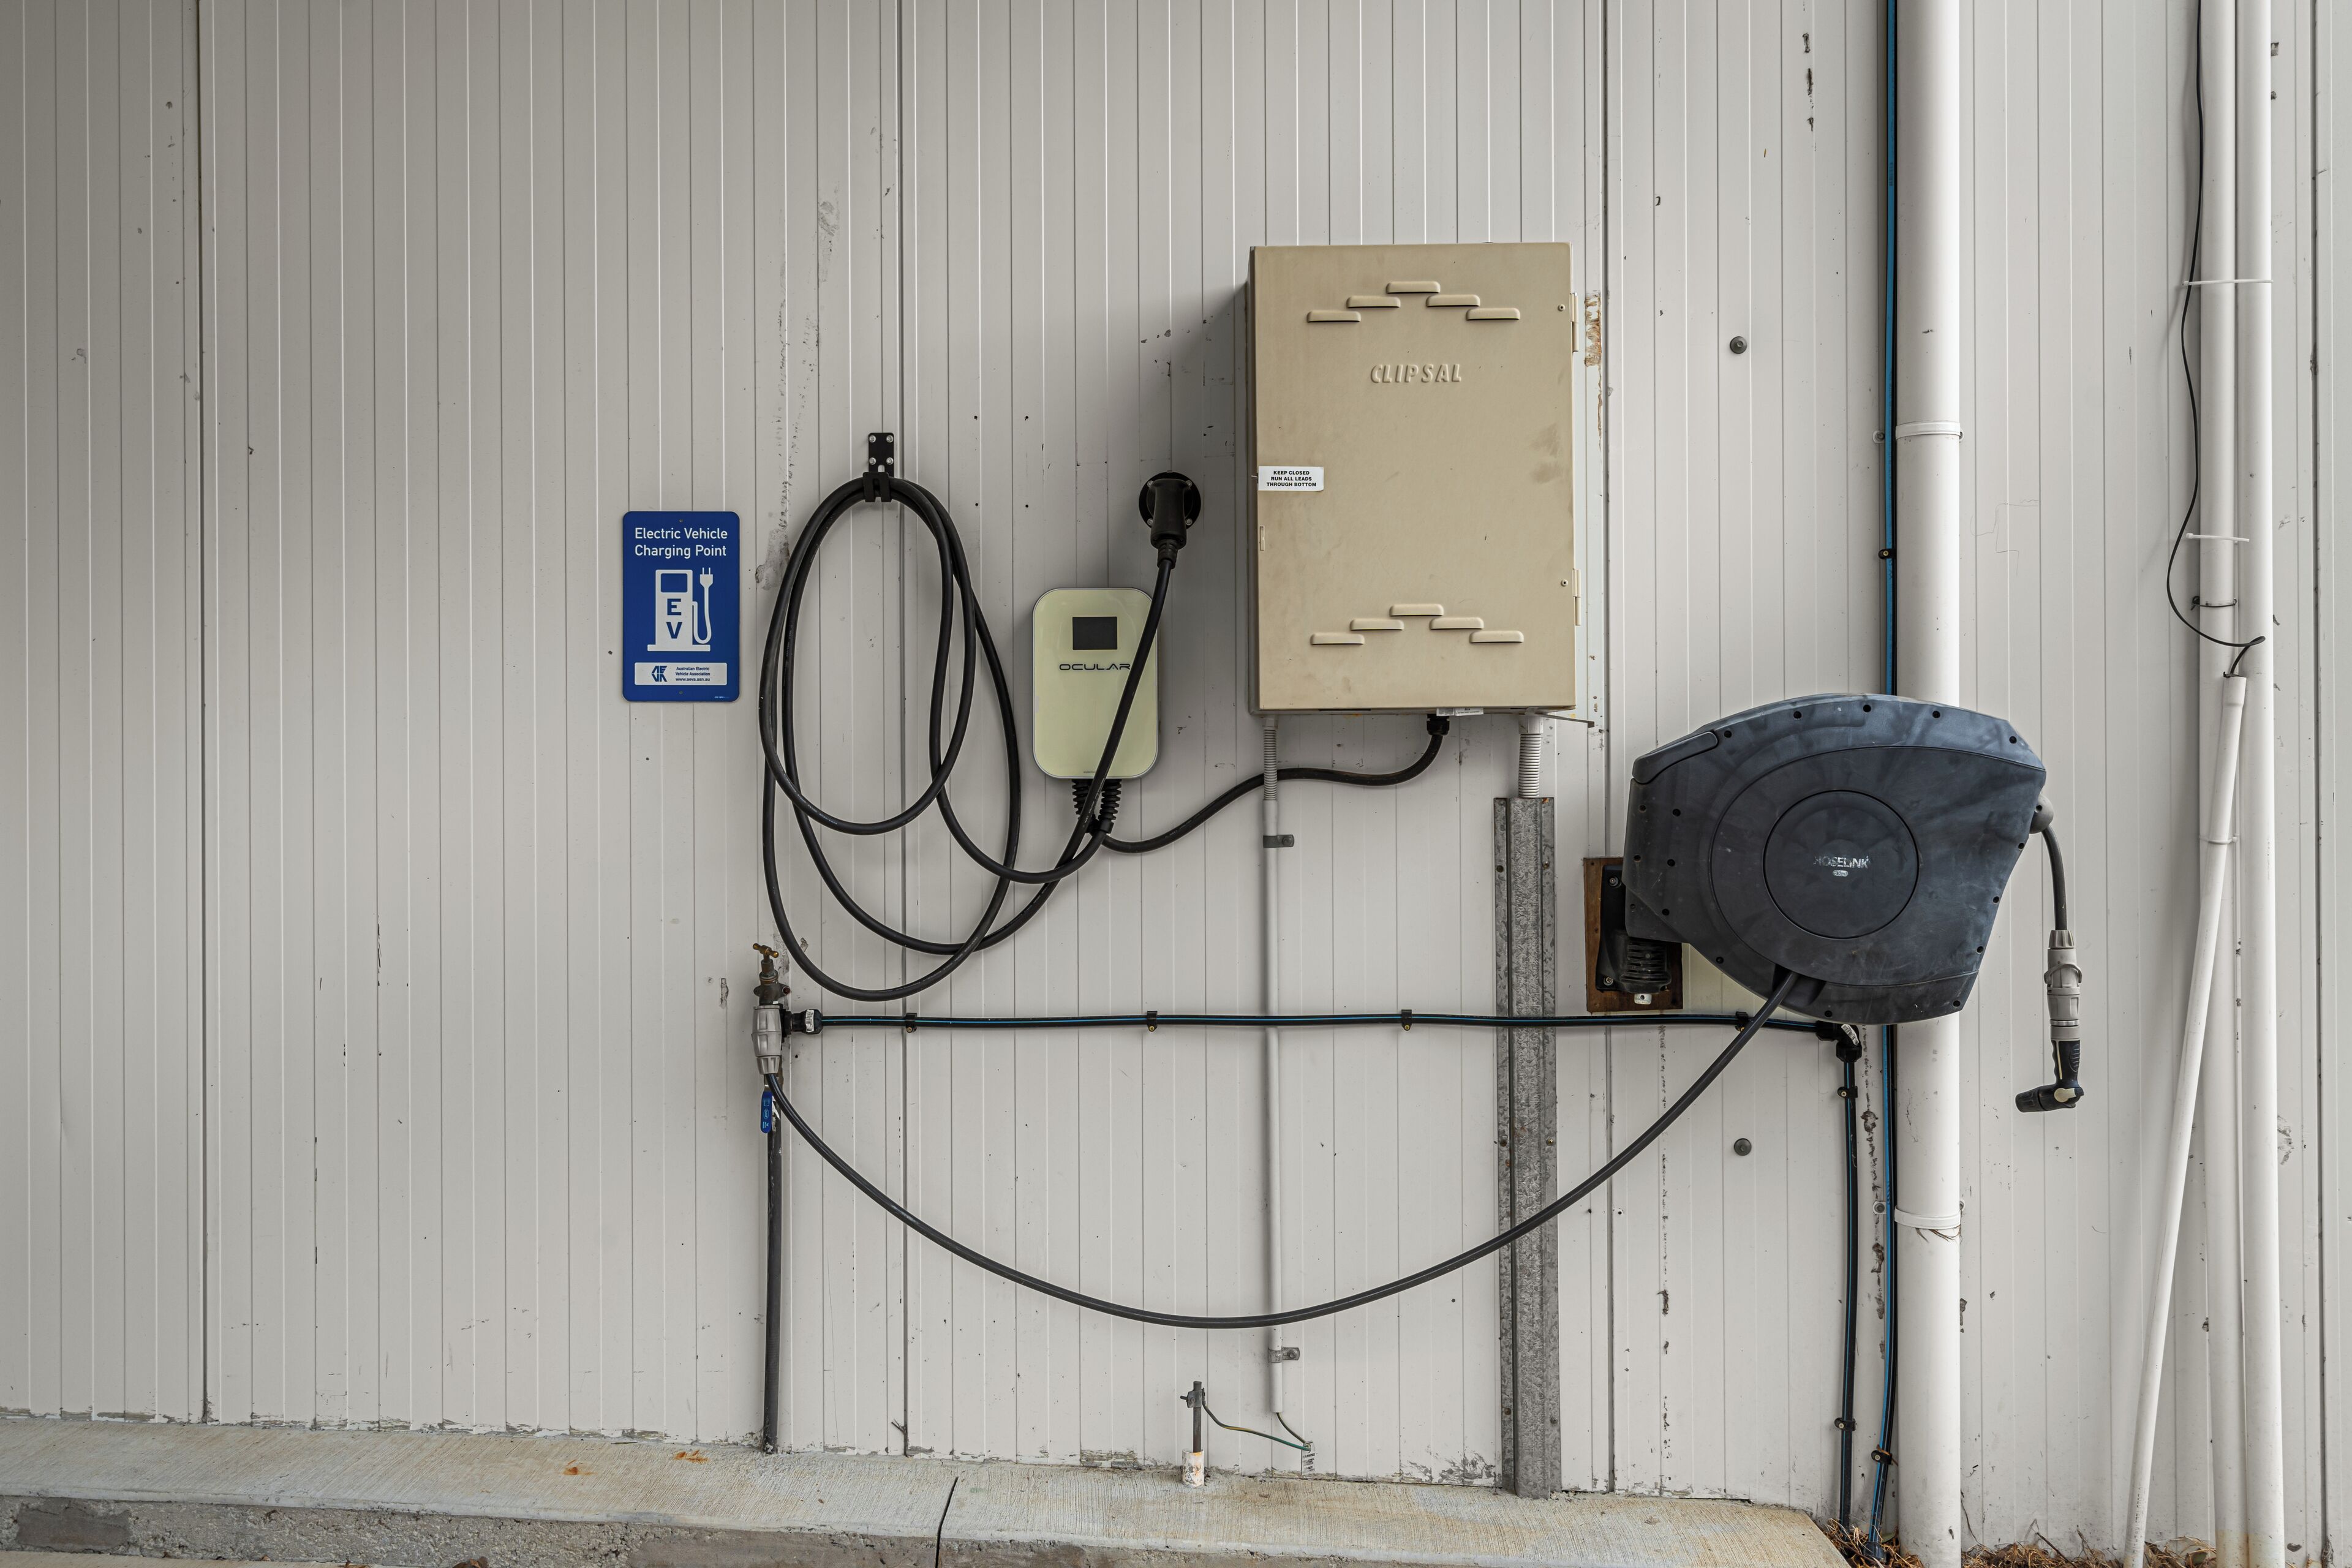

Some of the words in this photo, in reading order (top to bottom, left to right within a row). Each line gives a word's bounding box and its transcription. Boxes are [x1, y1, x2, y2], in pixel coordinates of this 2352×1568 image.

[1370, 364, 1461, 383] CLIPSAL
[635, 527, 680, 539] Electric
[684, 527, 728, 539] Vehicle
[635, 545, 691, 559] Charging
[695, 545, 726, 556] Point
